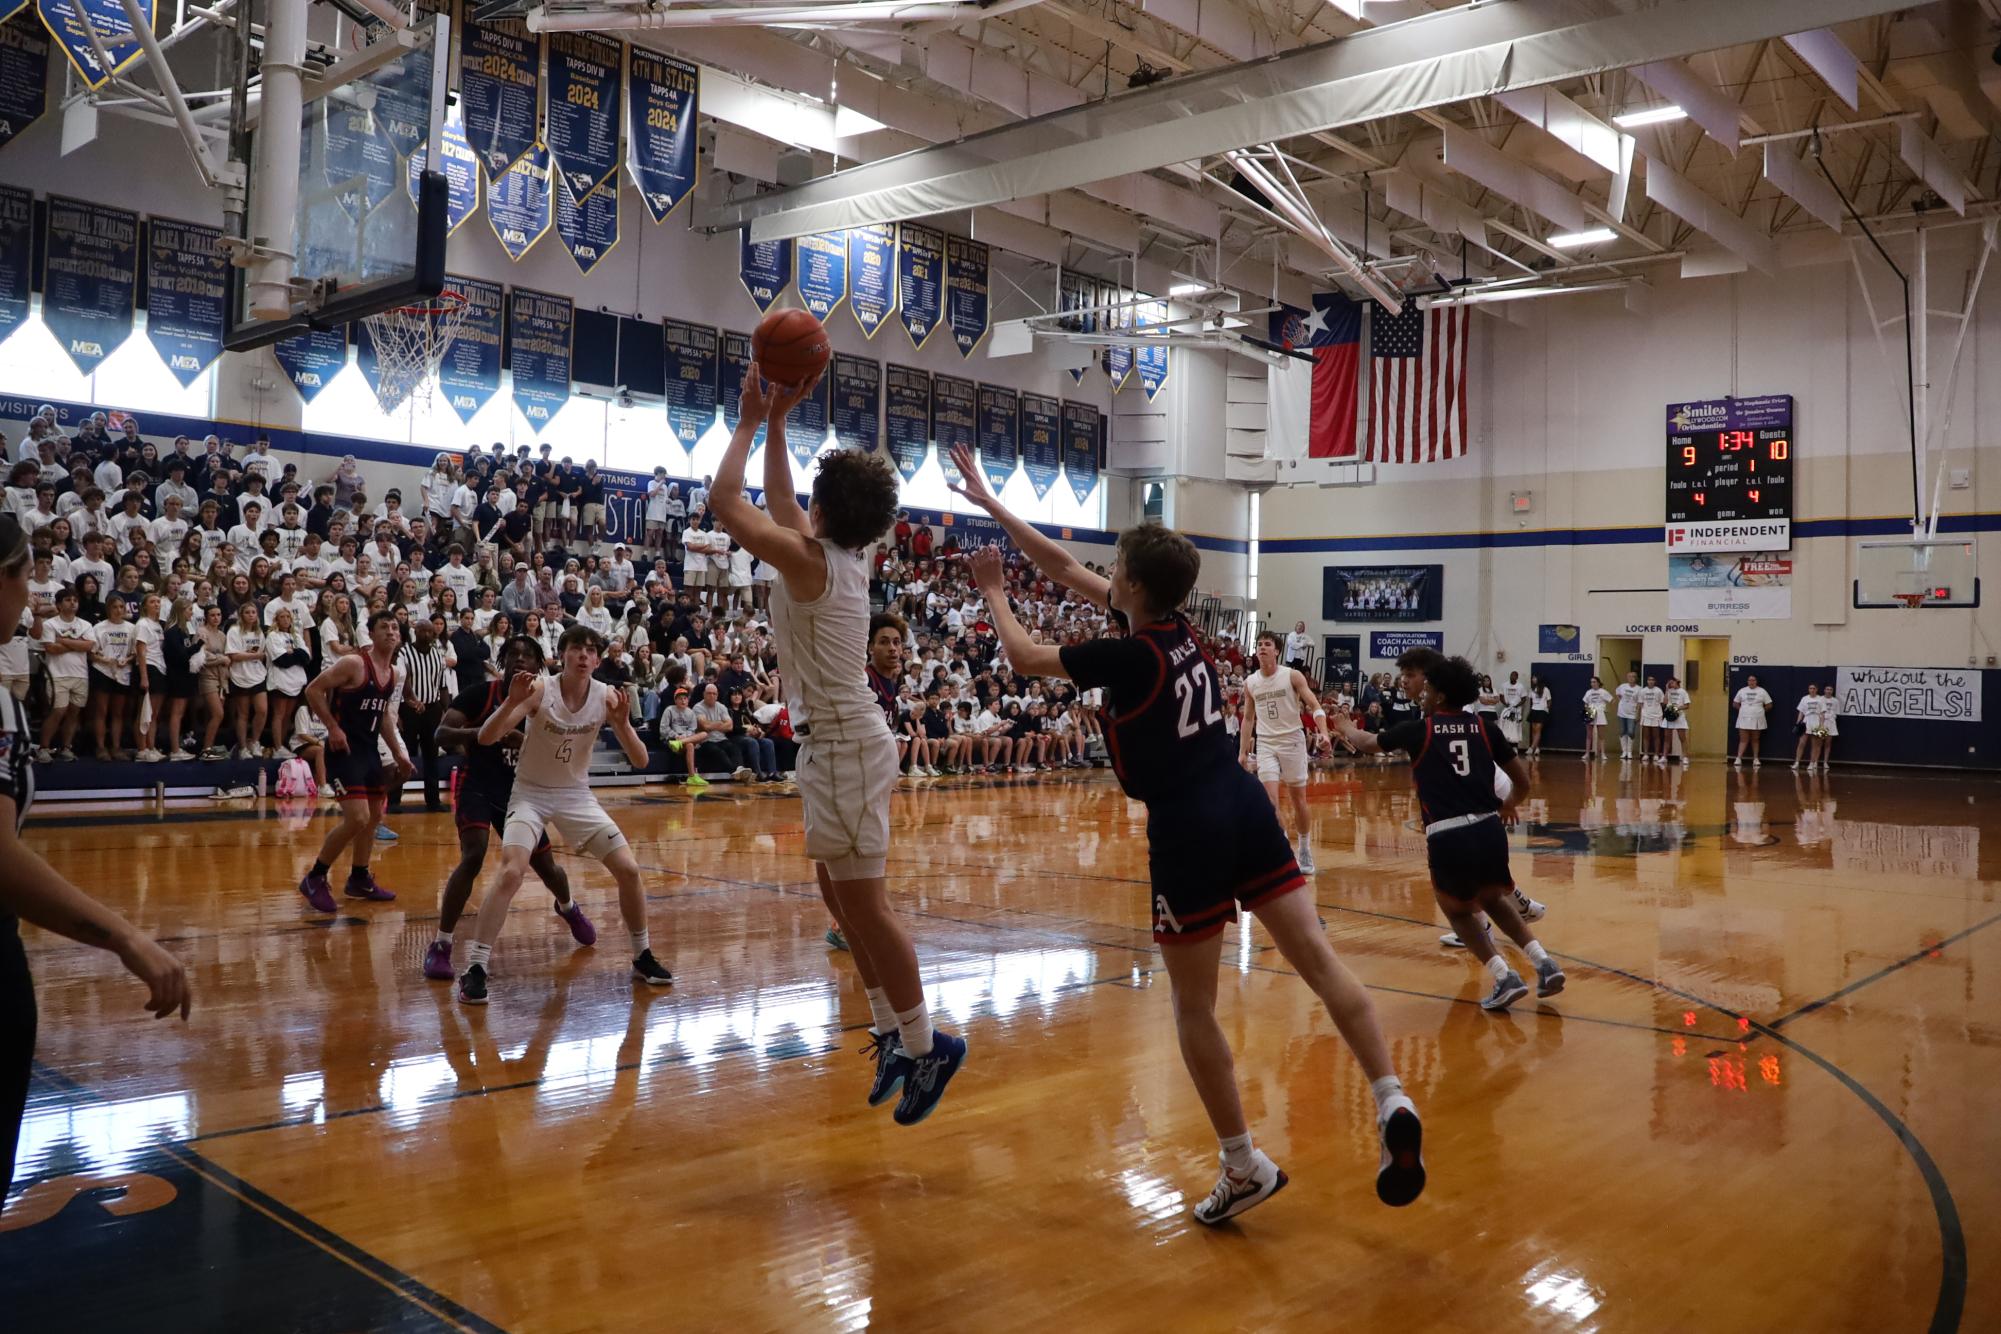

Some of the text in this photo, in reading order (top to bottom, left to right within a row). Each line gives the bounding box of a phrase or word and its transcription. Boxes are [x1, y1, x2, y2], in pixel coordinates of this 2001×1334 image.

[481, 30, 501, 45] TAPPS
[587, 32, 620, 48] CHRISTIAN
[483, 55, 517, 81] 2024
[565, 57, 586, 73] TAPPS
[586, 64, 598, 76] DIV
[664, 57, 696, 73] CHRISTIAN
[633, 59, 650, 79] 4TH
[665, 67, 695, 94] STATE
[567, 84, 599, 109] 2024
[650, 83, 669, 98] TAPPS
[648, 108, 677, 133] 2024
[177, 252, 196, 265] TAPPS
[153, 261, 225, 281] Girls Volleyball
[1682, 404, 1727, 418] Smiles
[1681, 423, 1727, 431] Orthodontics
[1672, 436, 1692, 445] Home
[1718, 431, 1754, 450] 1:34
[1759, 430, 1786, 440] Guests
[1683, 446, 1696, 466] 9
[1769, 440, 1788, 460] 10
[1714, 463, 1739, 475] period
[600, 474, 637, 487] STANGS
[1670, 481, 1687, 489] fouls
[1714, 477, 1739, 488] player
[1767, 475, 1785, 485] fouls
[1694, 493, 1705, 505] 4
[1748, 490, 1759, 503] 4
[1717, 510, 1736, 519] game
[1768, 508, 1784, 516] won
[1690, 525, 1787, 538] INDEPENDENT
[1690, 538, 1748, 546] FINANCIAL
[1744, 562, 1770, 571] FREE
[1625, 625, 1699, 633] LOCKER ROOMS
[1381, 646, 1399, 656] 400
[1568, 653, 1593, 661] GIRLS
[1733, 656, 1759, 664] BOYS
[1936, 672, 1966, 688] the
[1174, 661, 1222, 738] 22
[1843, 687, 1973, 718] ANGELS!
[1267, 701, 1279, 720] 5
[371, 716, 377, 732] 1
[1434, 724, 1479, 733] CASH II
[1449, 740, 1470, 776] 3
[1155, 894, 1183, 933] A
